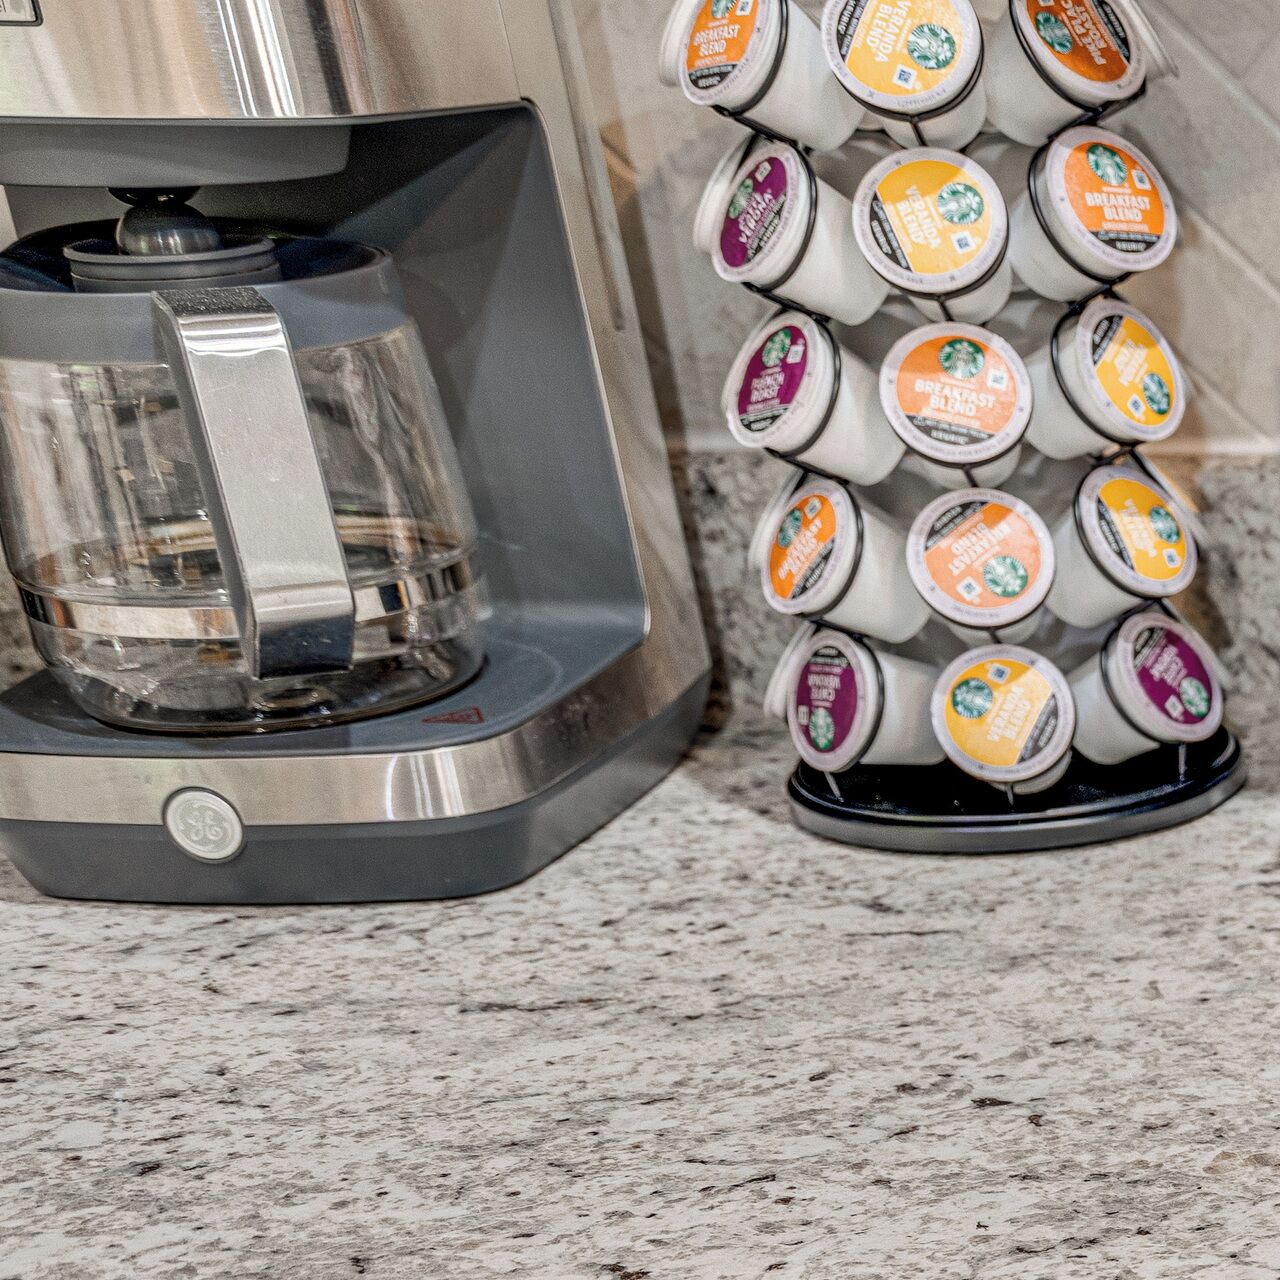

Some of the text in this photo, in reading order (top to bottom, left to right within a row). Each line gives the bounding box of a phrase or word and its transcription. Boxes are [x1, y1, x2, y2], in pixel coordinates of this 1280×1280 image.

[693, 24, 741, 46] BREAKFAST
[700, 39, 727, 57] BLEND
[1084, 191, 1150, 211] BREAKFAST
[1103, 206, 1142, 222] BLEND
[914, 378, 996, 409] BREAKFAST
[930, 395, 977, 417] BLEND
